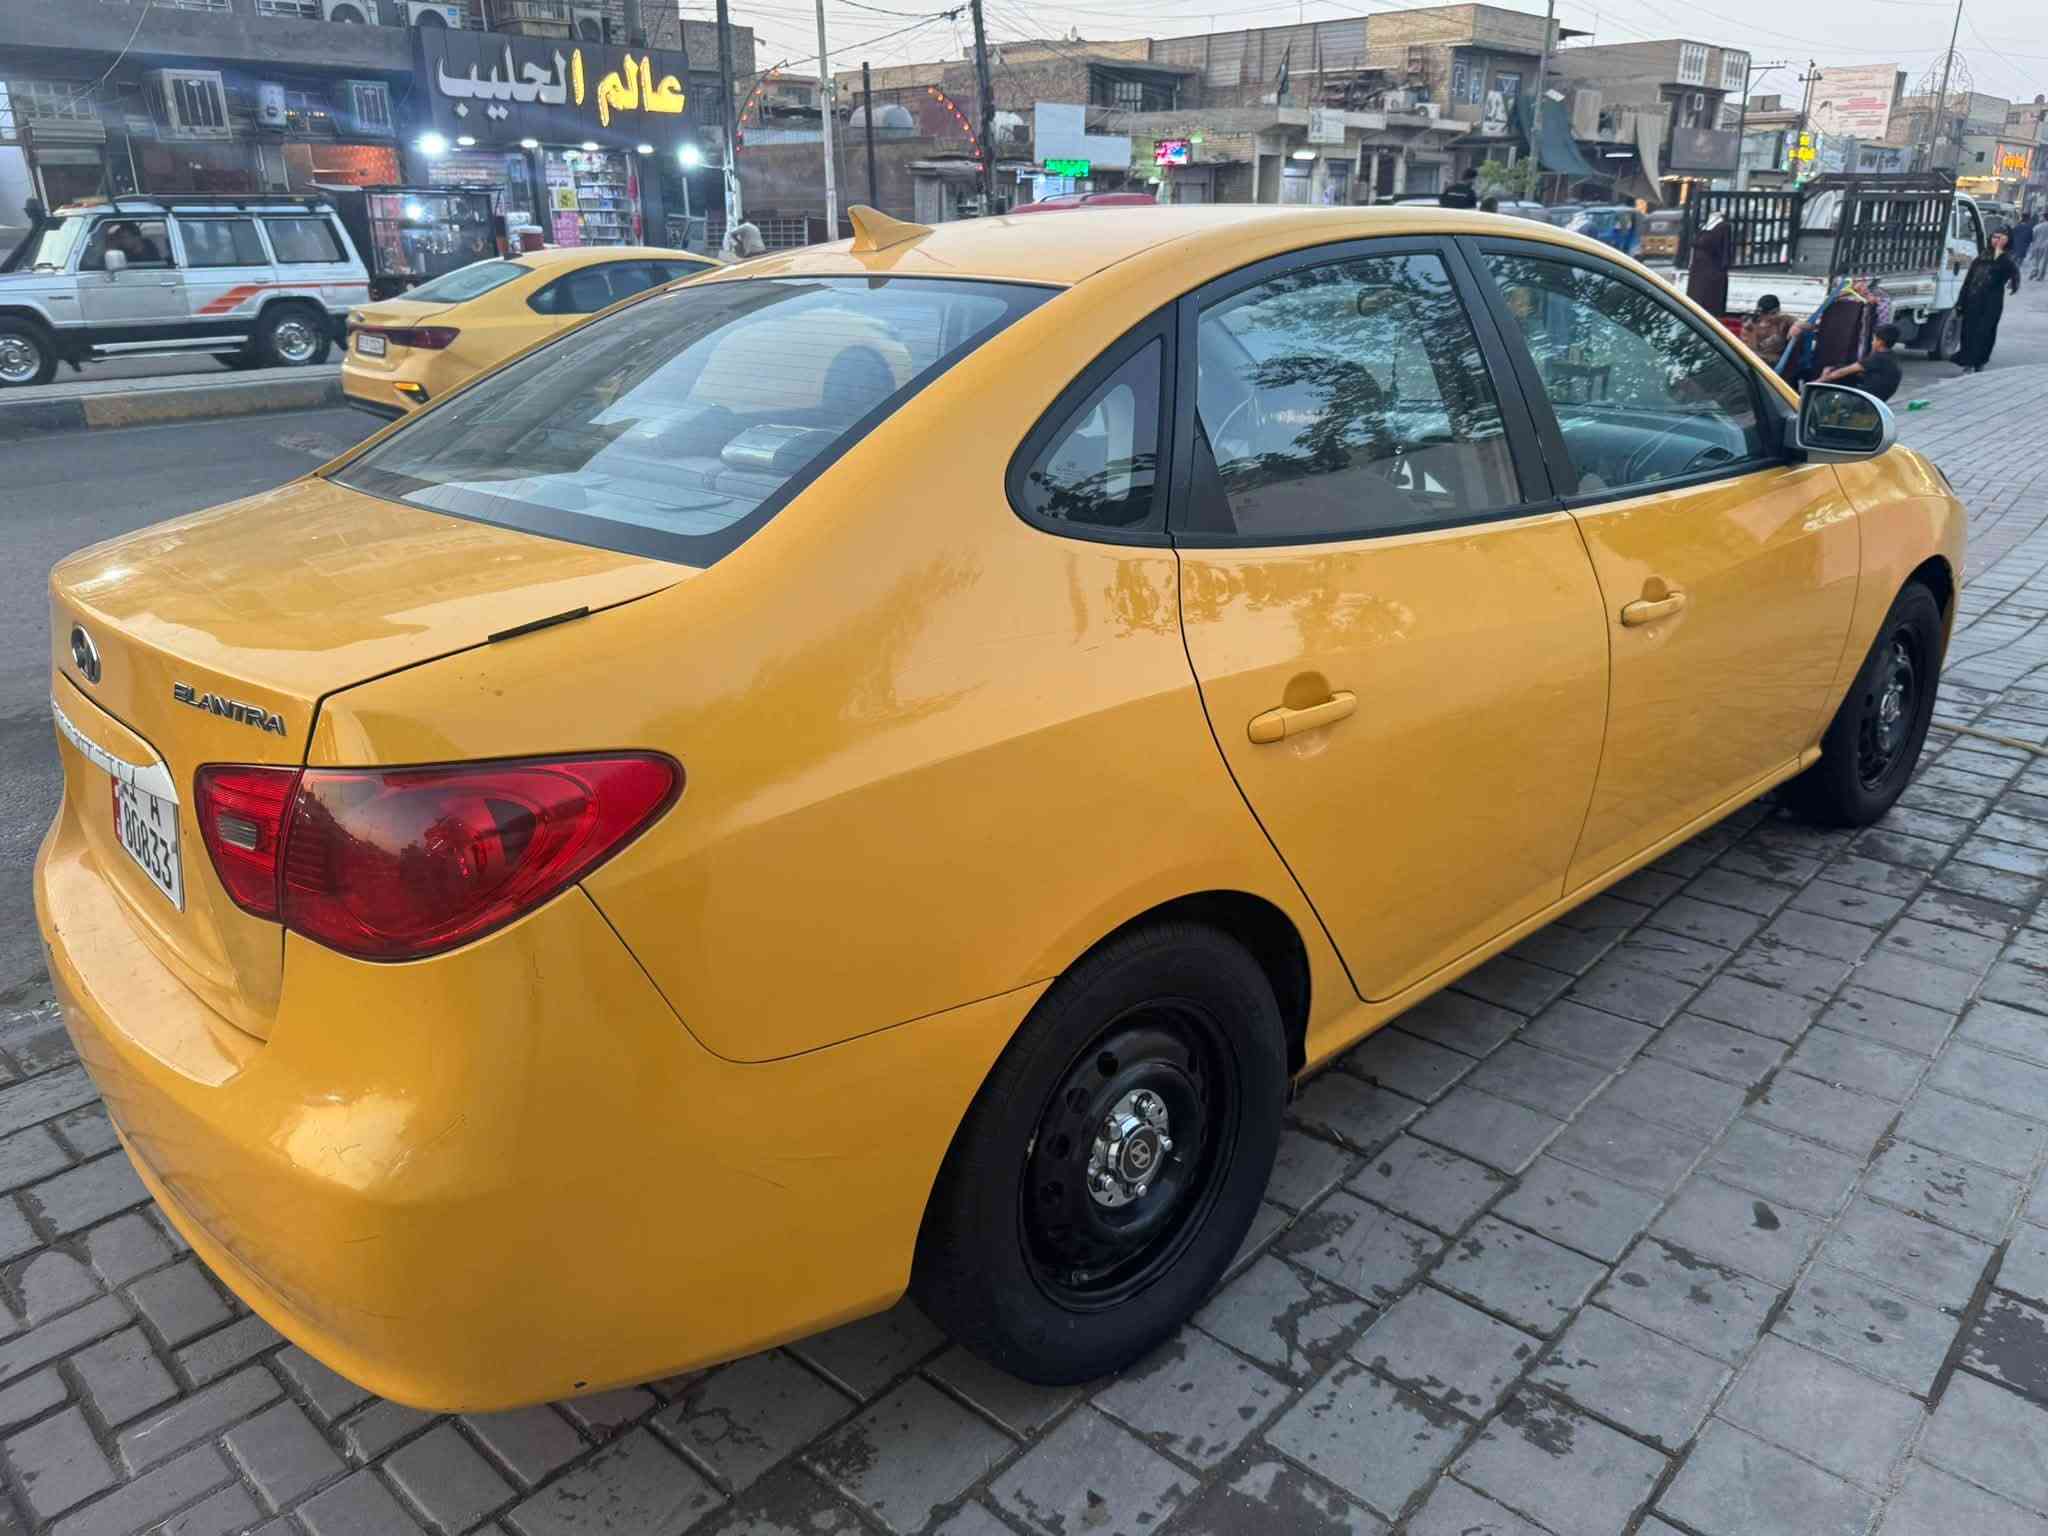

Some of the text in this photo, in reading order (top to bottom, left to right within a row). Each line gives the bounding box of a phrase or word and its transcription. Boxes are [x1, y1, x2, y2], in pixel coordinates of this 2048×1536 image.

[438, 44, 685, 127] عالم الحليب
[174, 681, 287, 737] ELANTRA
